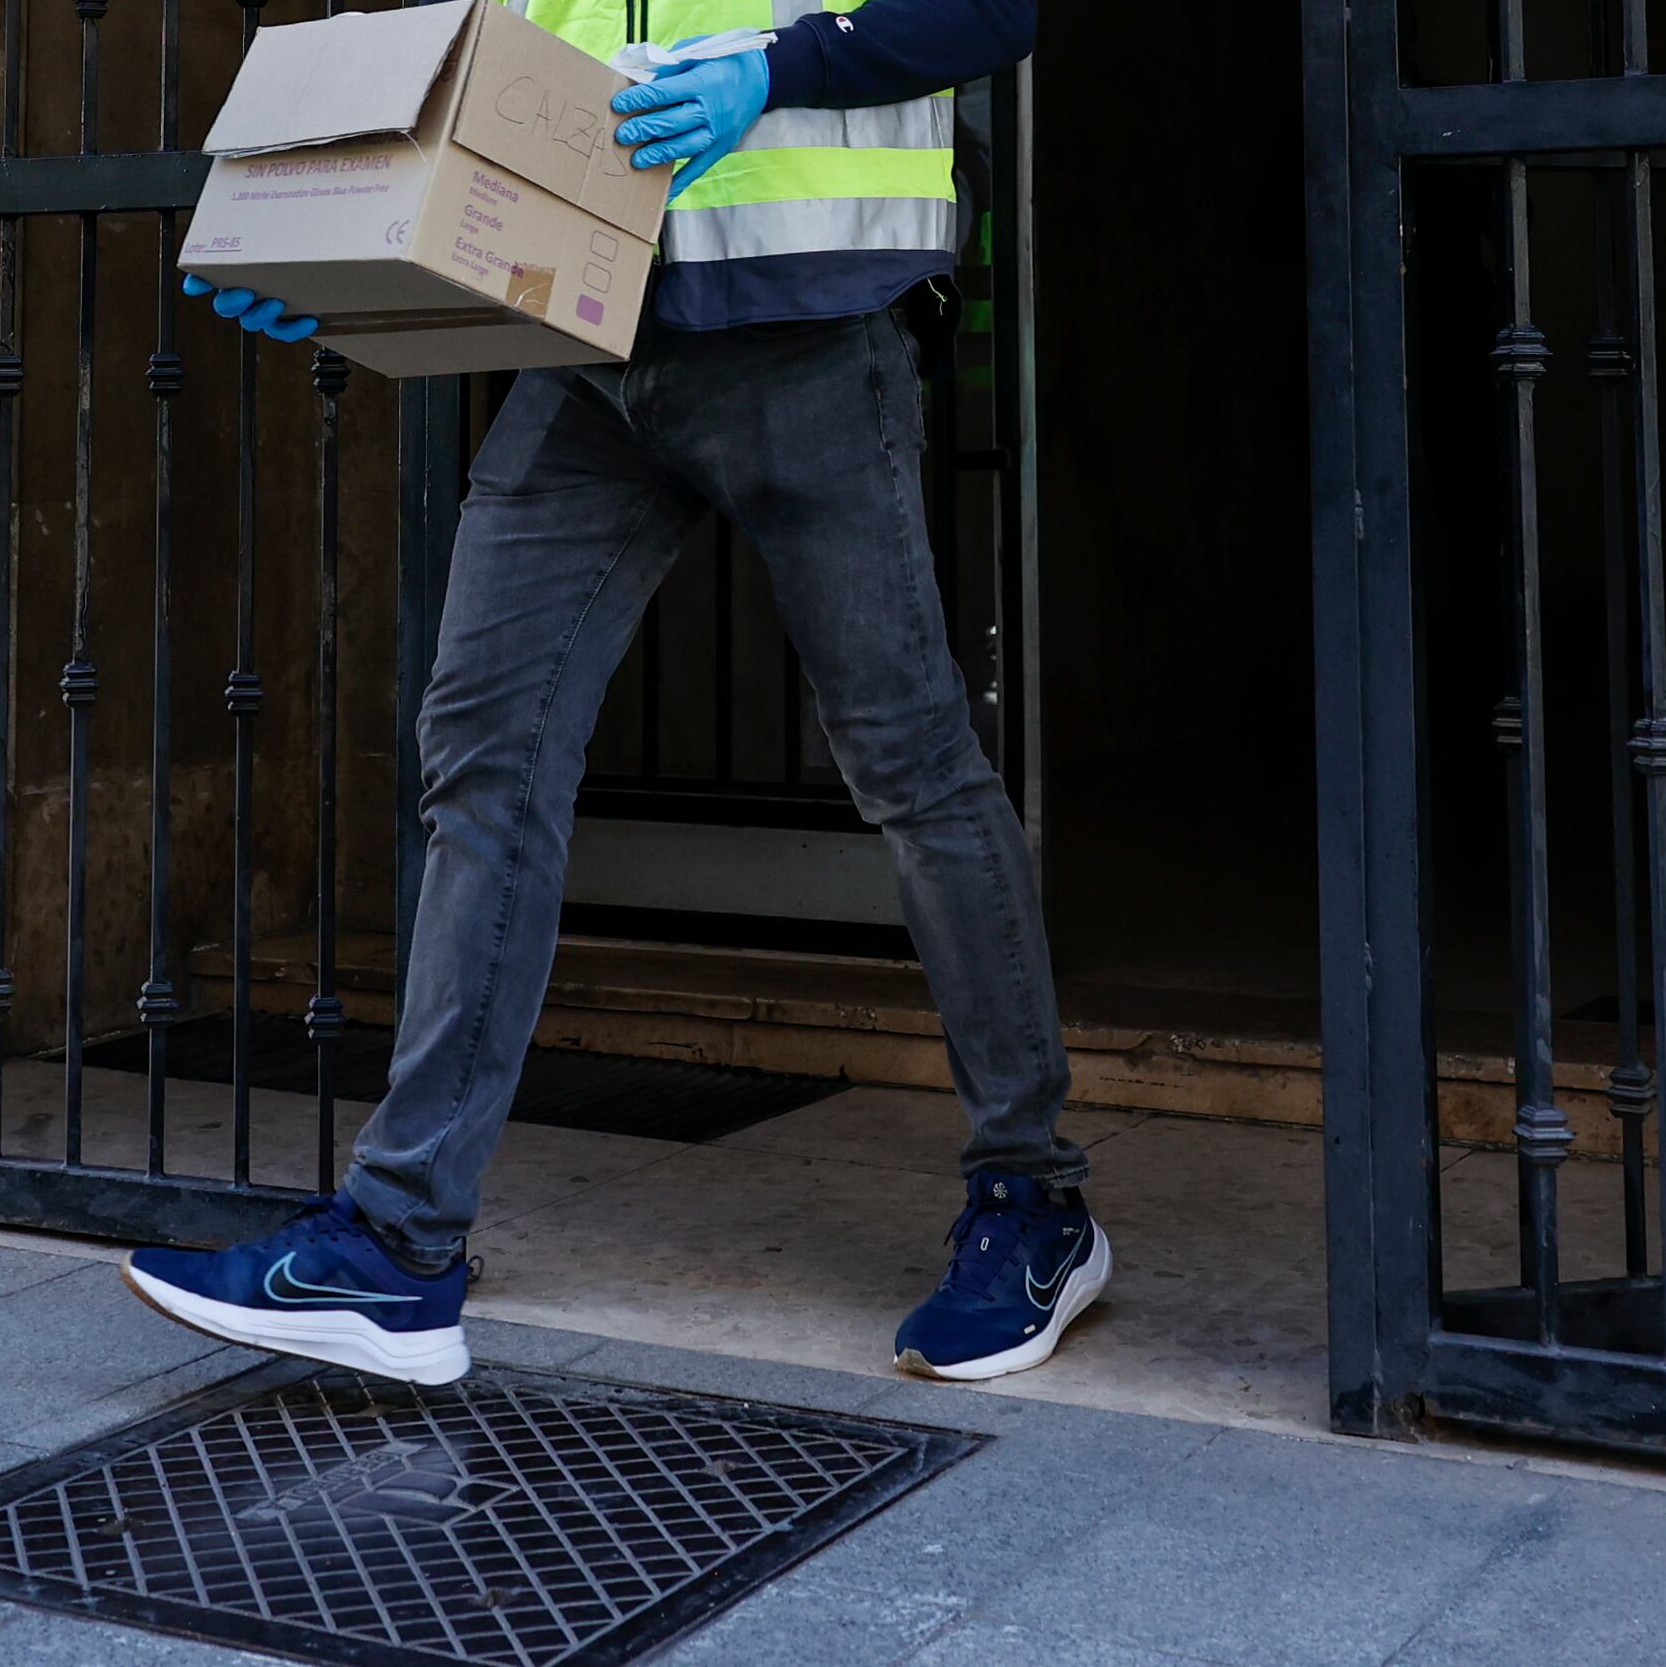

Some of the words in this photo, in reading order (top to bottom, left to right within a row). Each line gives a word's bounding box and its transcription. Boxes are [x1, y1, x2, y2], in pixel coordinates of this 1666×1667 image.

[245, 164, 266, 179] SIN
[267, 160, 306, 178] POLVO
[308, 158, 337, 174] PARA
[340, 154, 393, 173] EXAMEN
[473, 171, 519, 203] Mediana
[460, 219, 479, 234] Large
[464, 204, 503, 231] Grande
[455, 236, 483, 259] Extra
[485, 251, 524, 278] Grande
